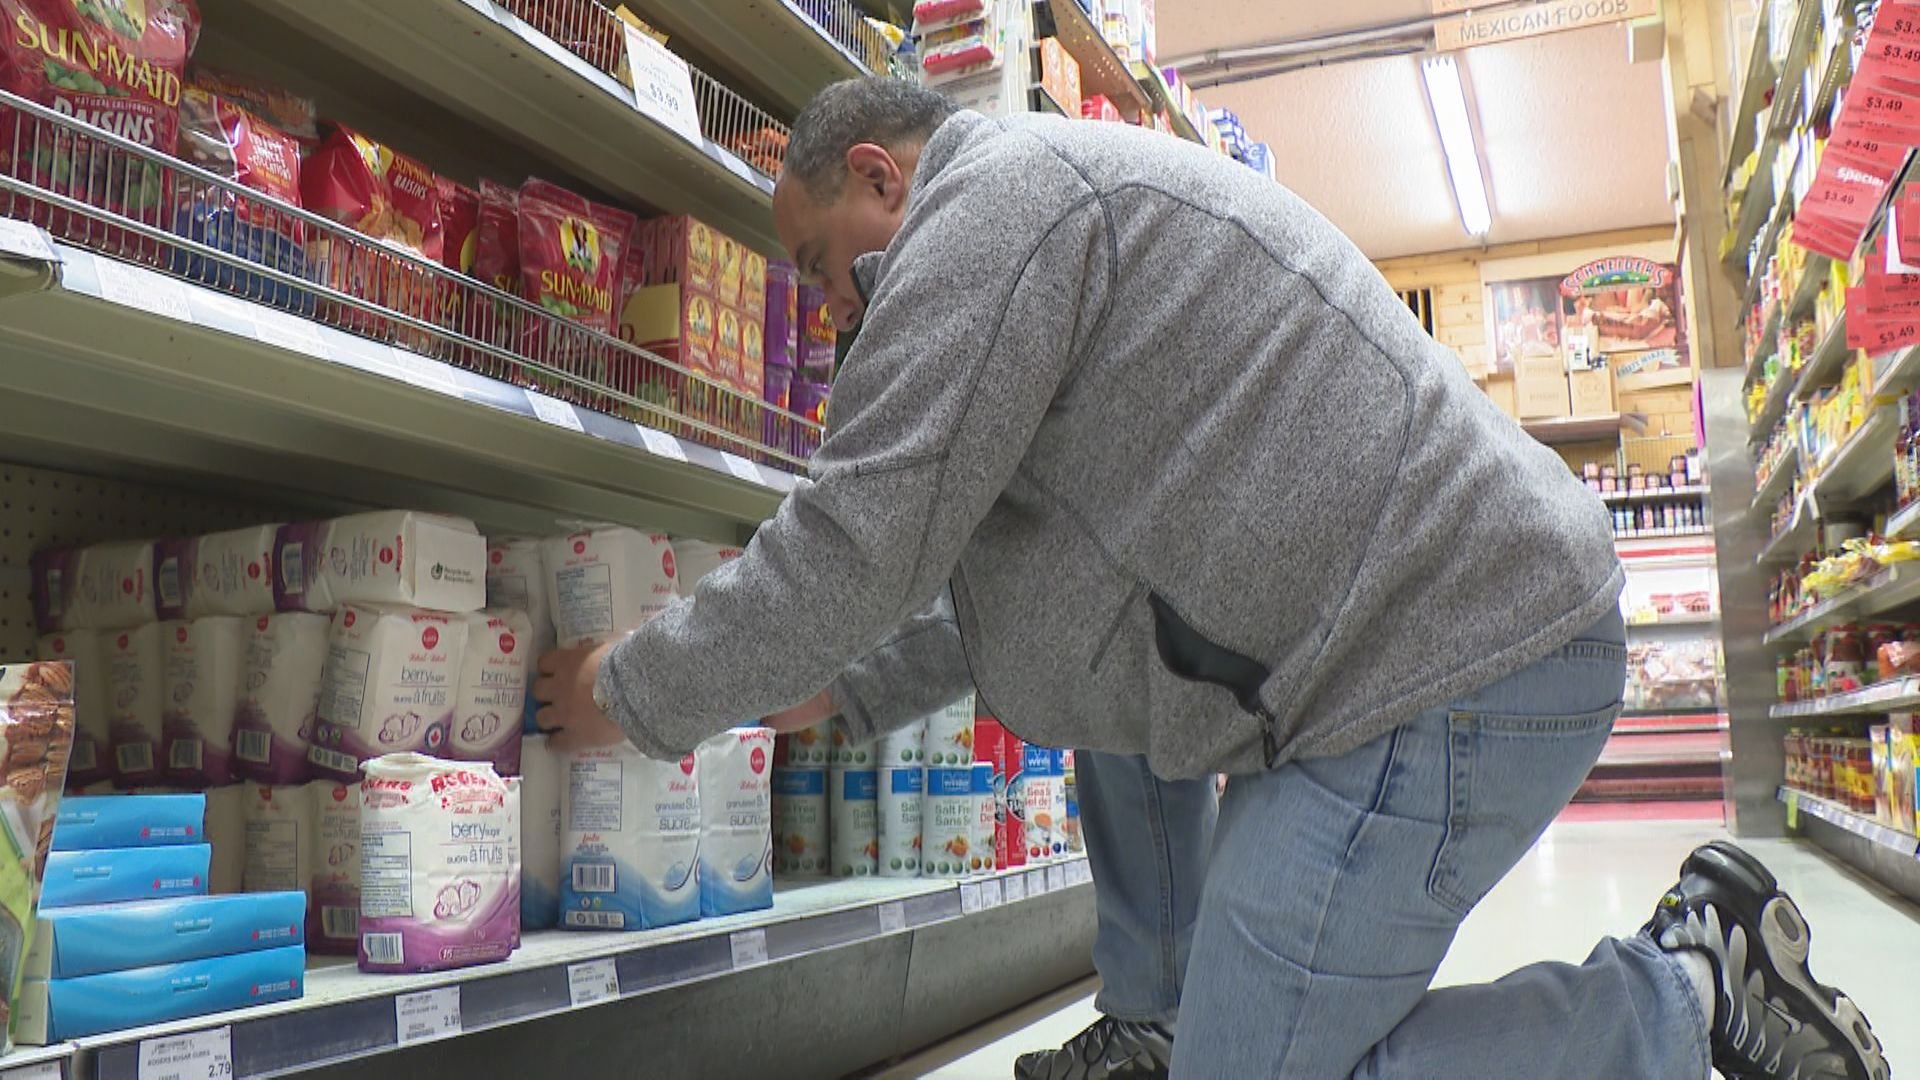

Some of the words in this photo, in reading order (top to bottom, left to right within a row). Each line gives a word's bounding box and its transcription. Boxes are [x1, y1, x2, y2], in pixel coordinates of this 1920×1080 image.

[1460, 10, 1549, 42] MEXICAN
[1555, 1, 1629, 25] FOODS
[1865, 96, 1903, 112] $3.49
[1824, 190, 1855, 204] $3.49
[401, 667, 430, 684] berry
[481, 667, 509, 685] berry
[935, 804, 955, 815] Salt
[659, 815, 691, 831] sucre
[729, 814, 762, 826] sucre
[451, 820, 485, 840] berry
[208, 1062, 231, 1078] 2.79
